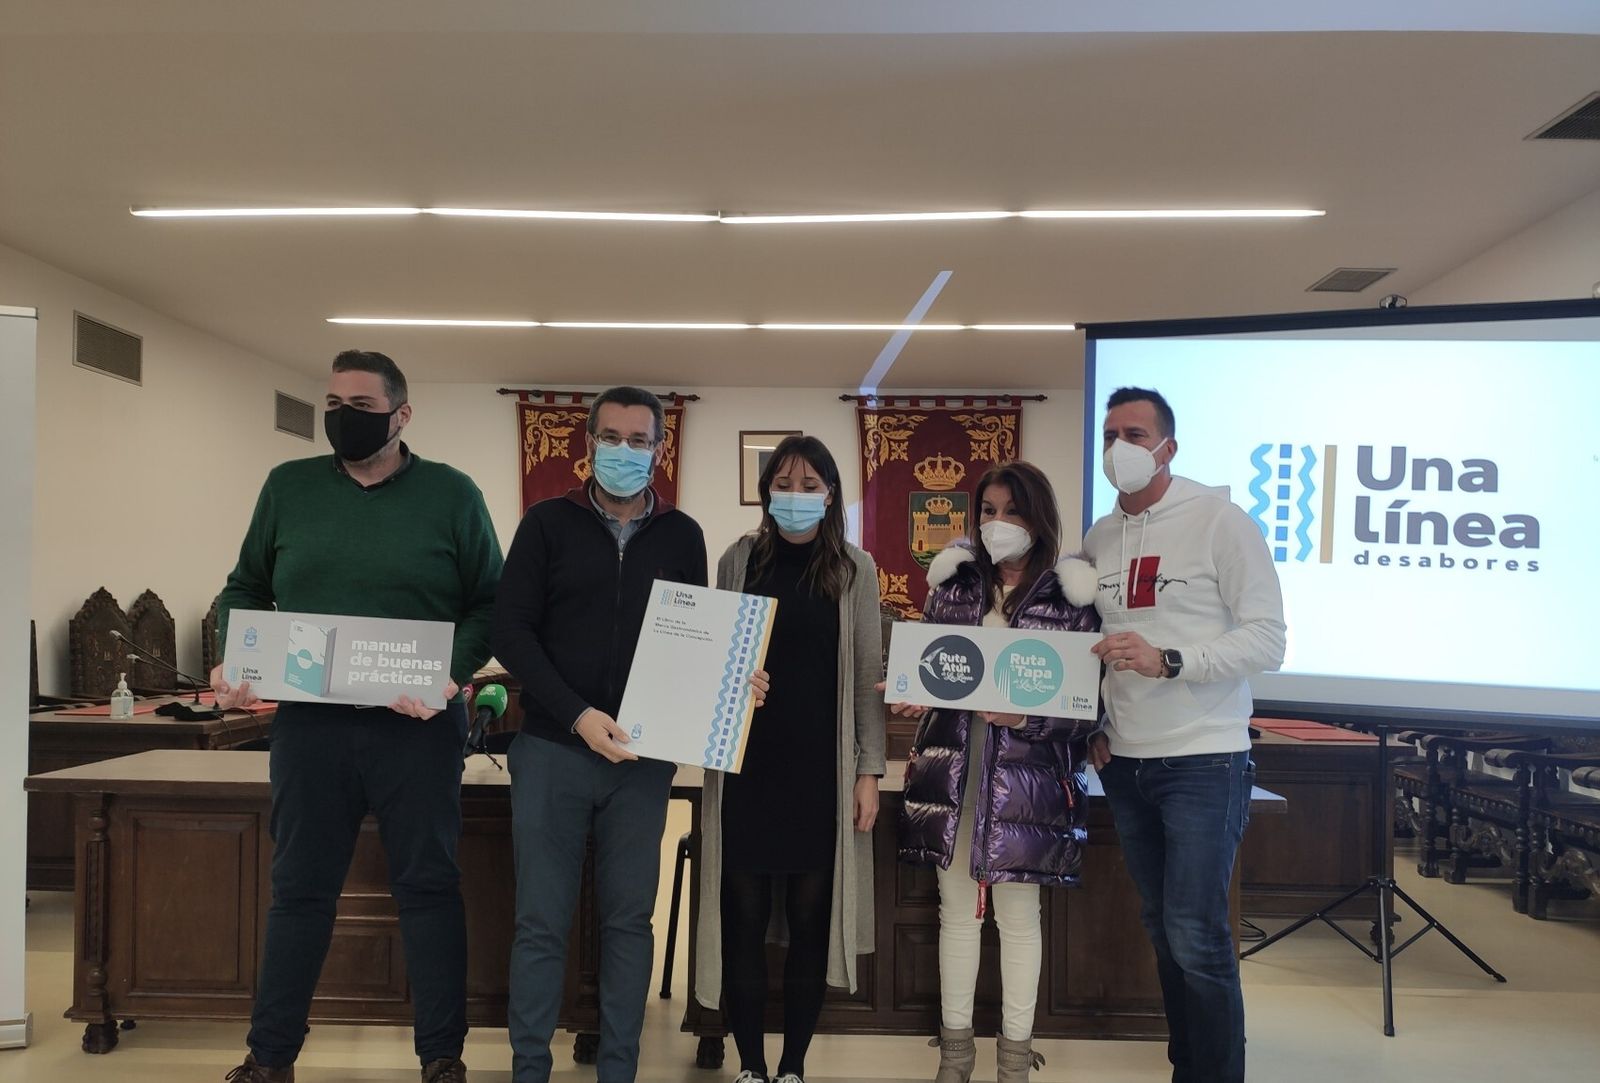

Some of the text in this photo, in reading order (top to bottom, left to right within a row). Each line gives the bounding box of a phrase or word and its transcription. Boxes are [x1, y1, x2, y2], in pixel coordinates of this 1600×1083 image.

[1357, 445, 1498, 493] Una
[675, 590, 693, 599] Una
[351, 640, 417, 654] manual
[350, 652, 443, 671] de buenas
[939, 652, 967, 664] Ruta
[1010, 653, 1047, 666] Ruta
[242, 667, 259, 675] Una
[942, 662, 971, 674] Atún
[1015, 665, 1053, 681] Tapa
[347, 669, 434, 686] prácticas
[1072, 695, 1089, 703] Una
